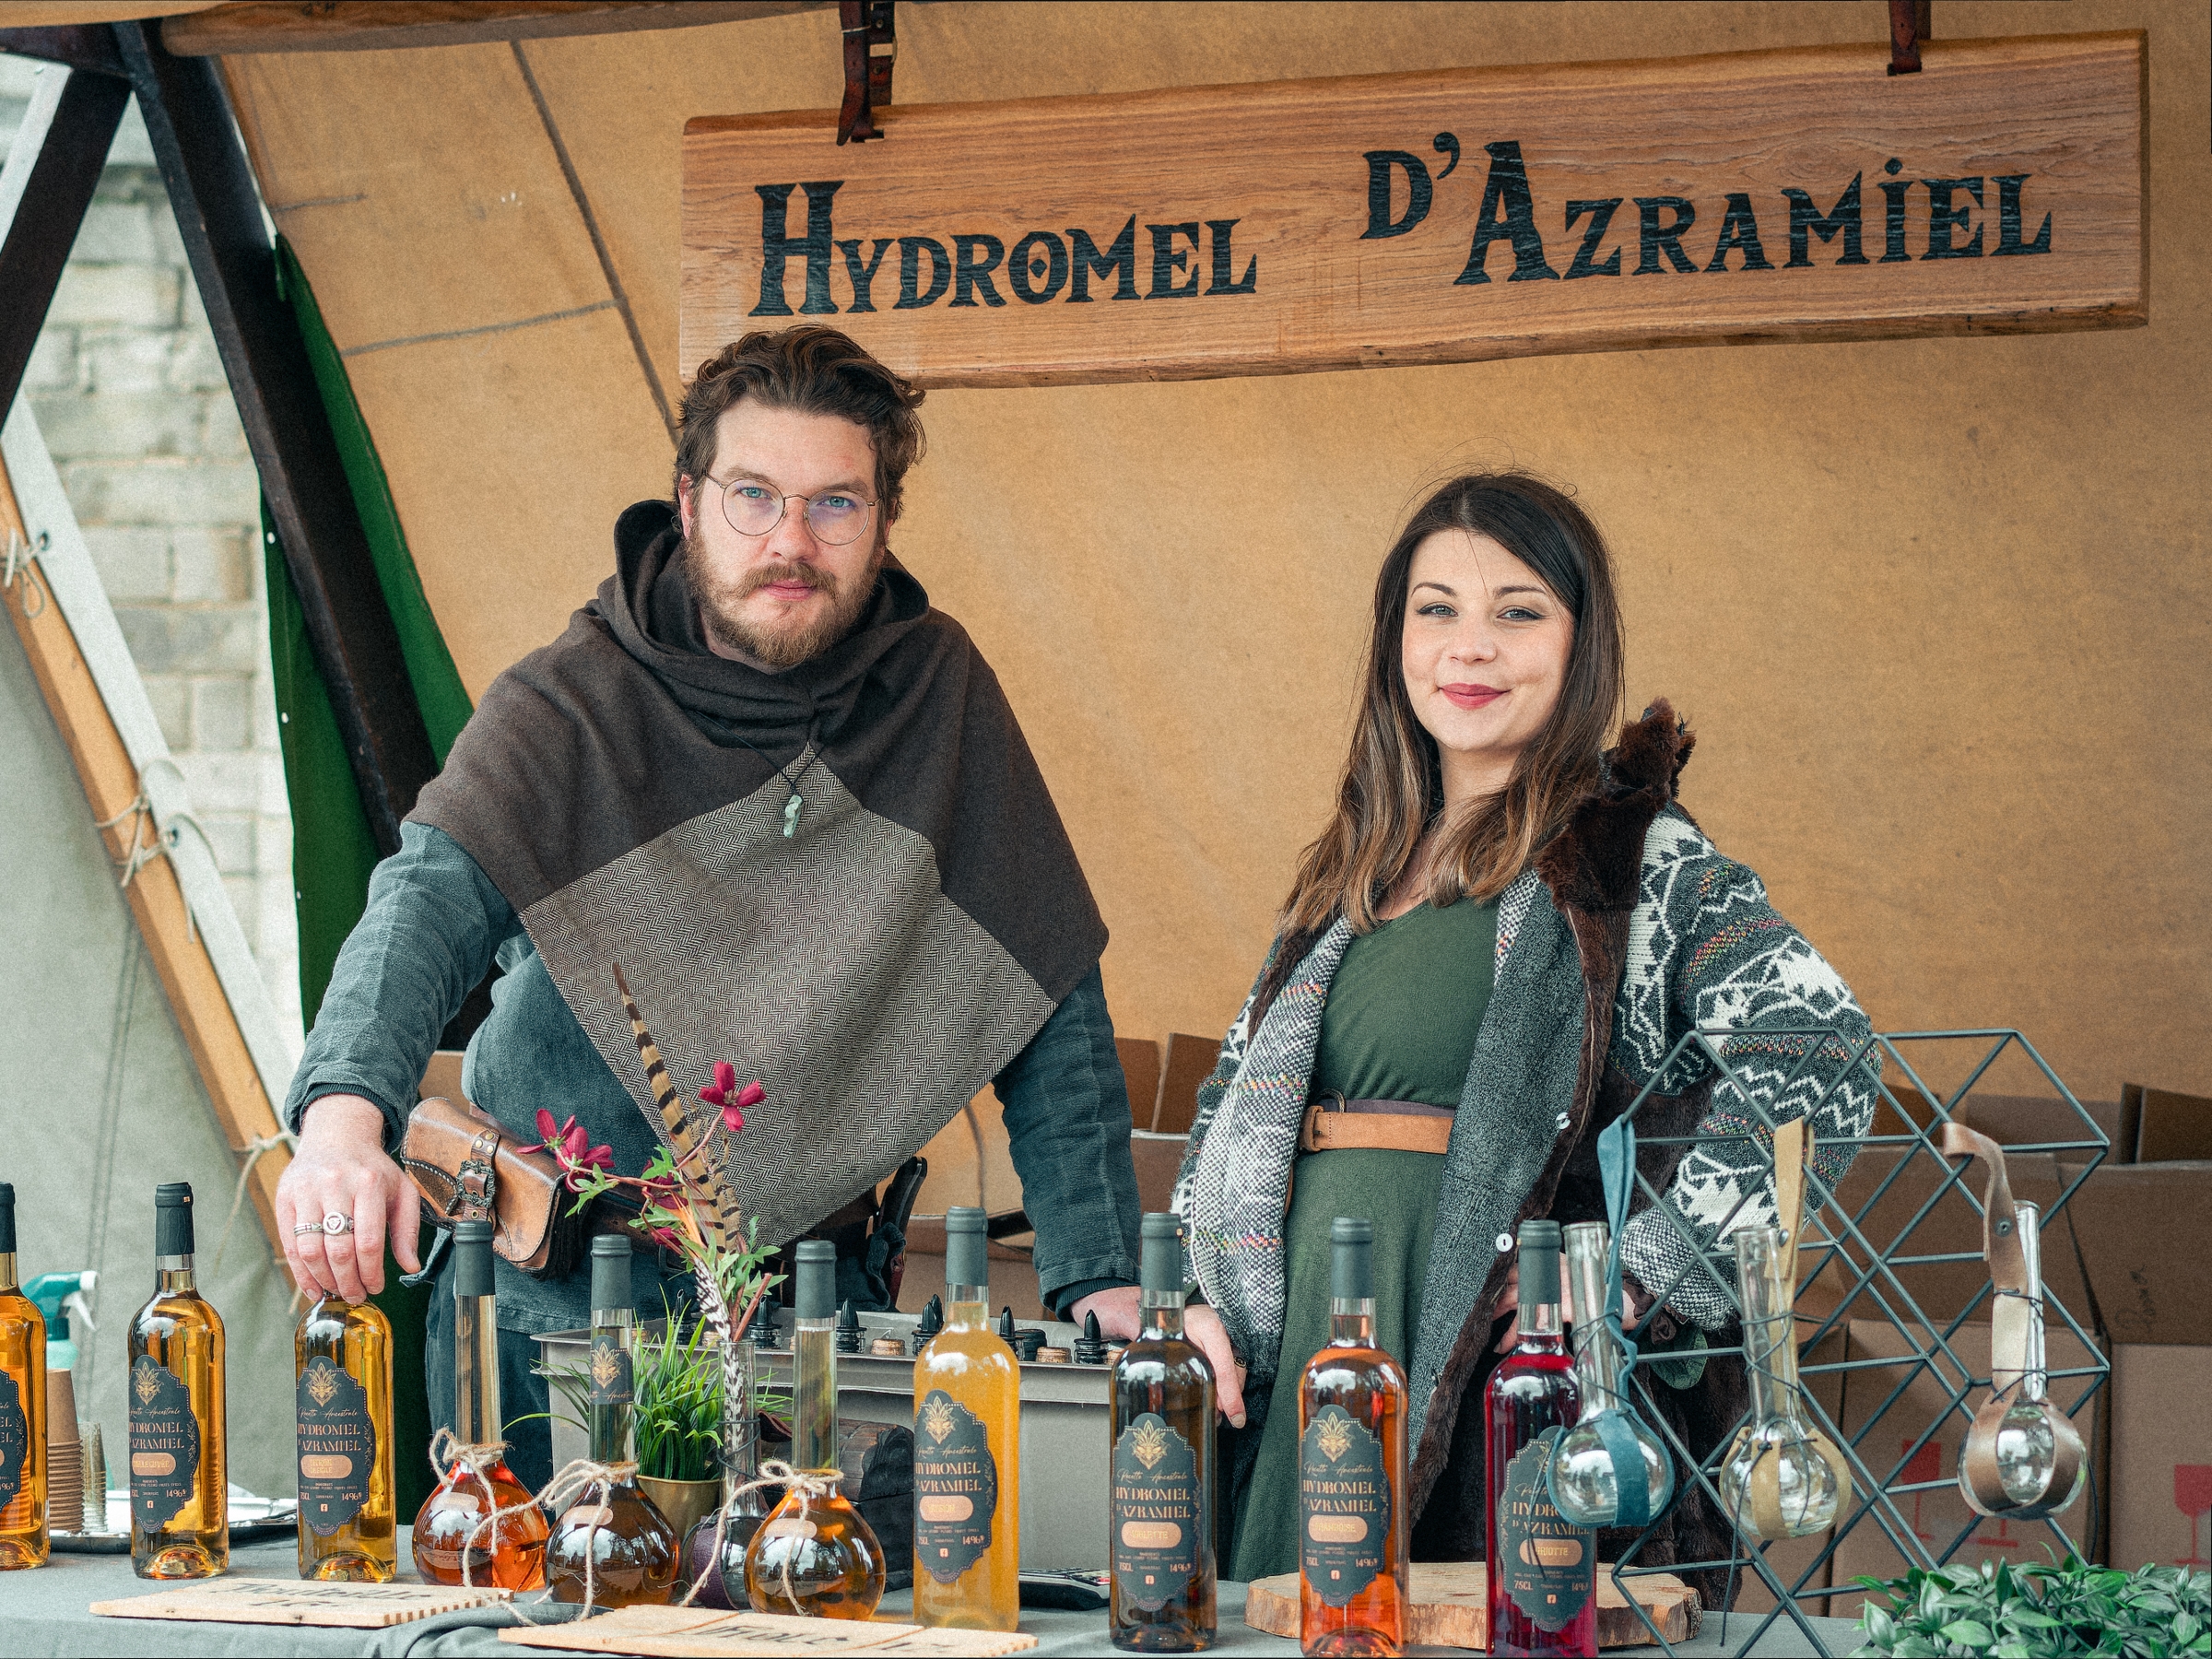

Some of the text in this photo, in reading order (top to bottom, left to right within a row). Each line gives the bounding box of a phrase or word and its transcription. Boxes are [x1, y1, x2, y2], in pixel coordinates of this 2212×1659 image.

[747, 180, 1256, 316] HYDROMEL
[298, 1423, 360, 1435] HYDROMEL
[915, 1462, 981, 1475] HYDROMEL
[1115, 1486, 1191, 1500] HYDROMEL
[1302, 1479, 1376, 1494] HYDROMEL
[1513, 1580, 1534, 1591] 75CL
